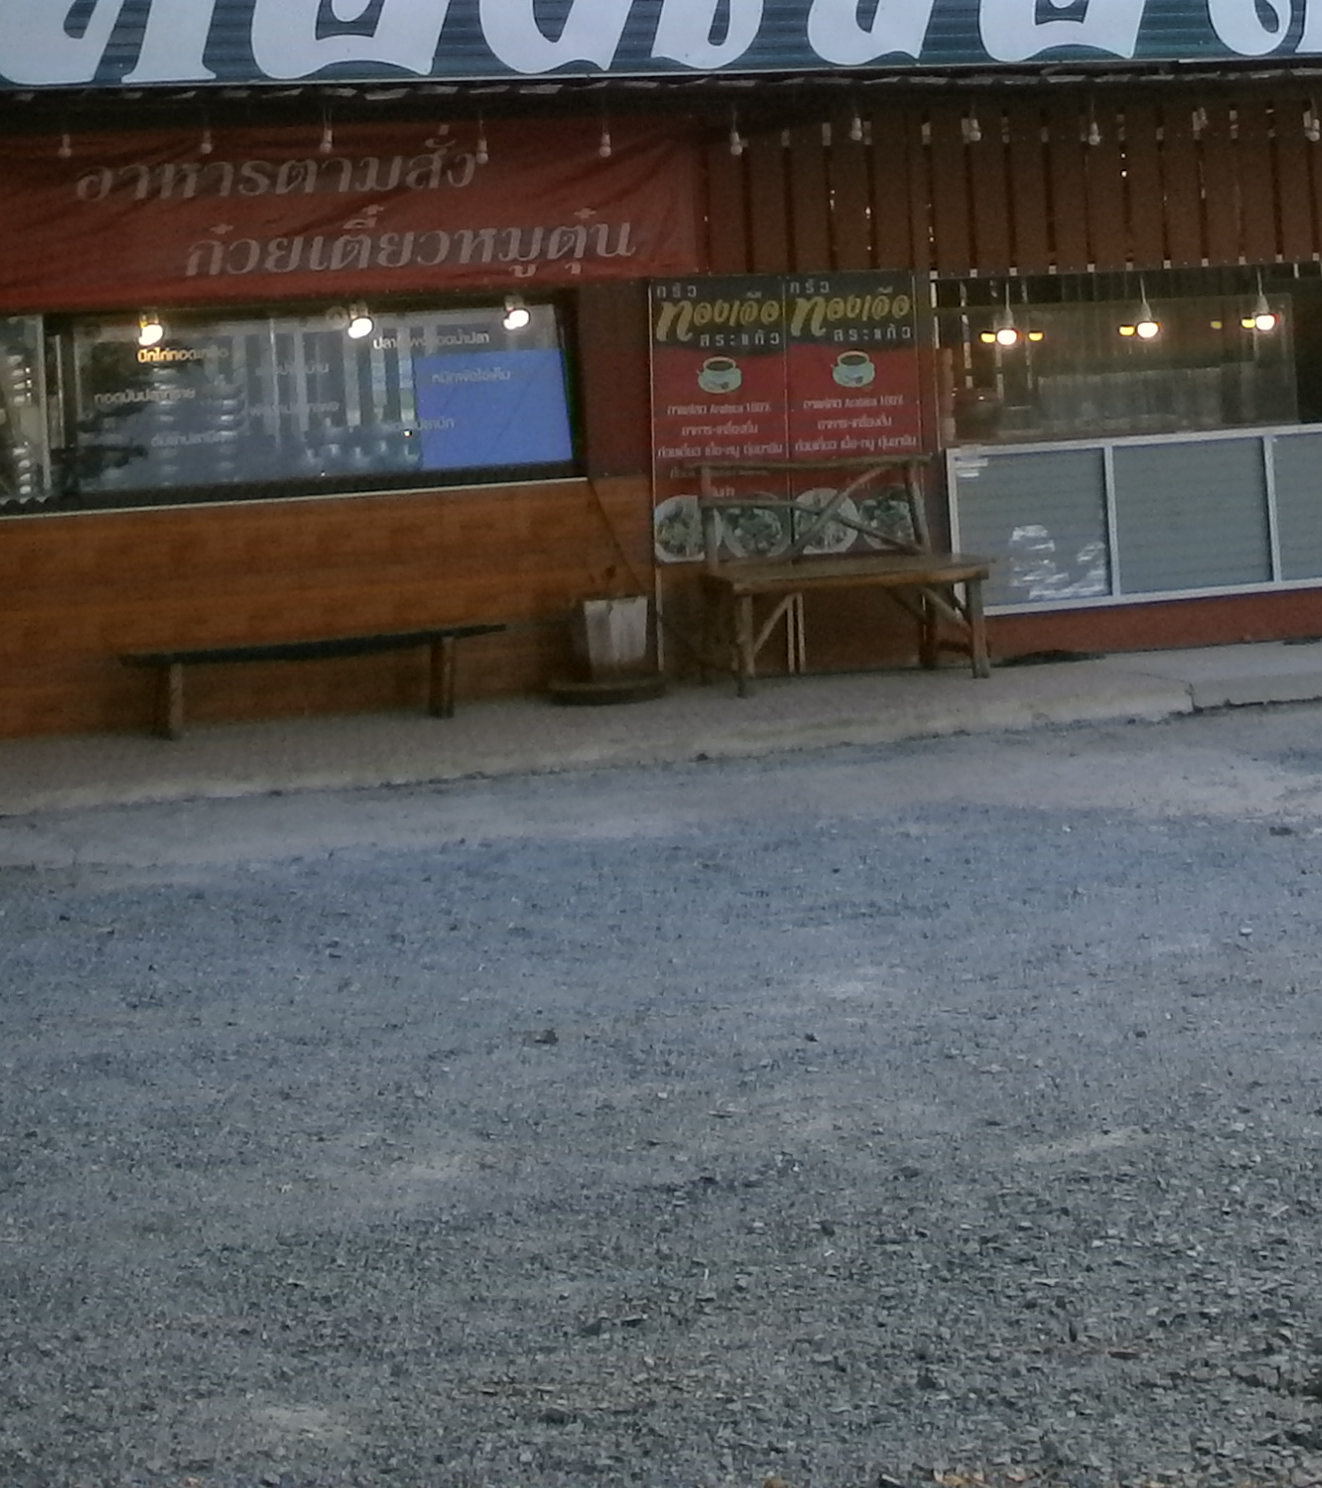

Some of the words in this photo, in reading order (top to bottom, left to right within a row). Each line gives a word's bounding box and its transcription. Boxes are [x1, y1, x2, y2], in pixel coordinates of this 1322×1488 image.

[77, 124, 477, 202] อาหารตามสั่ง
